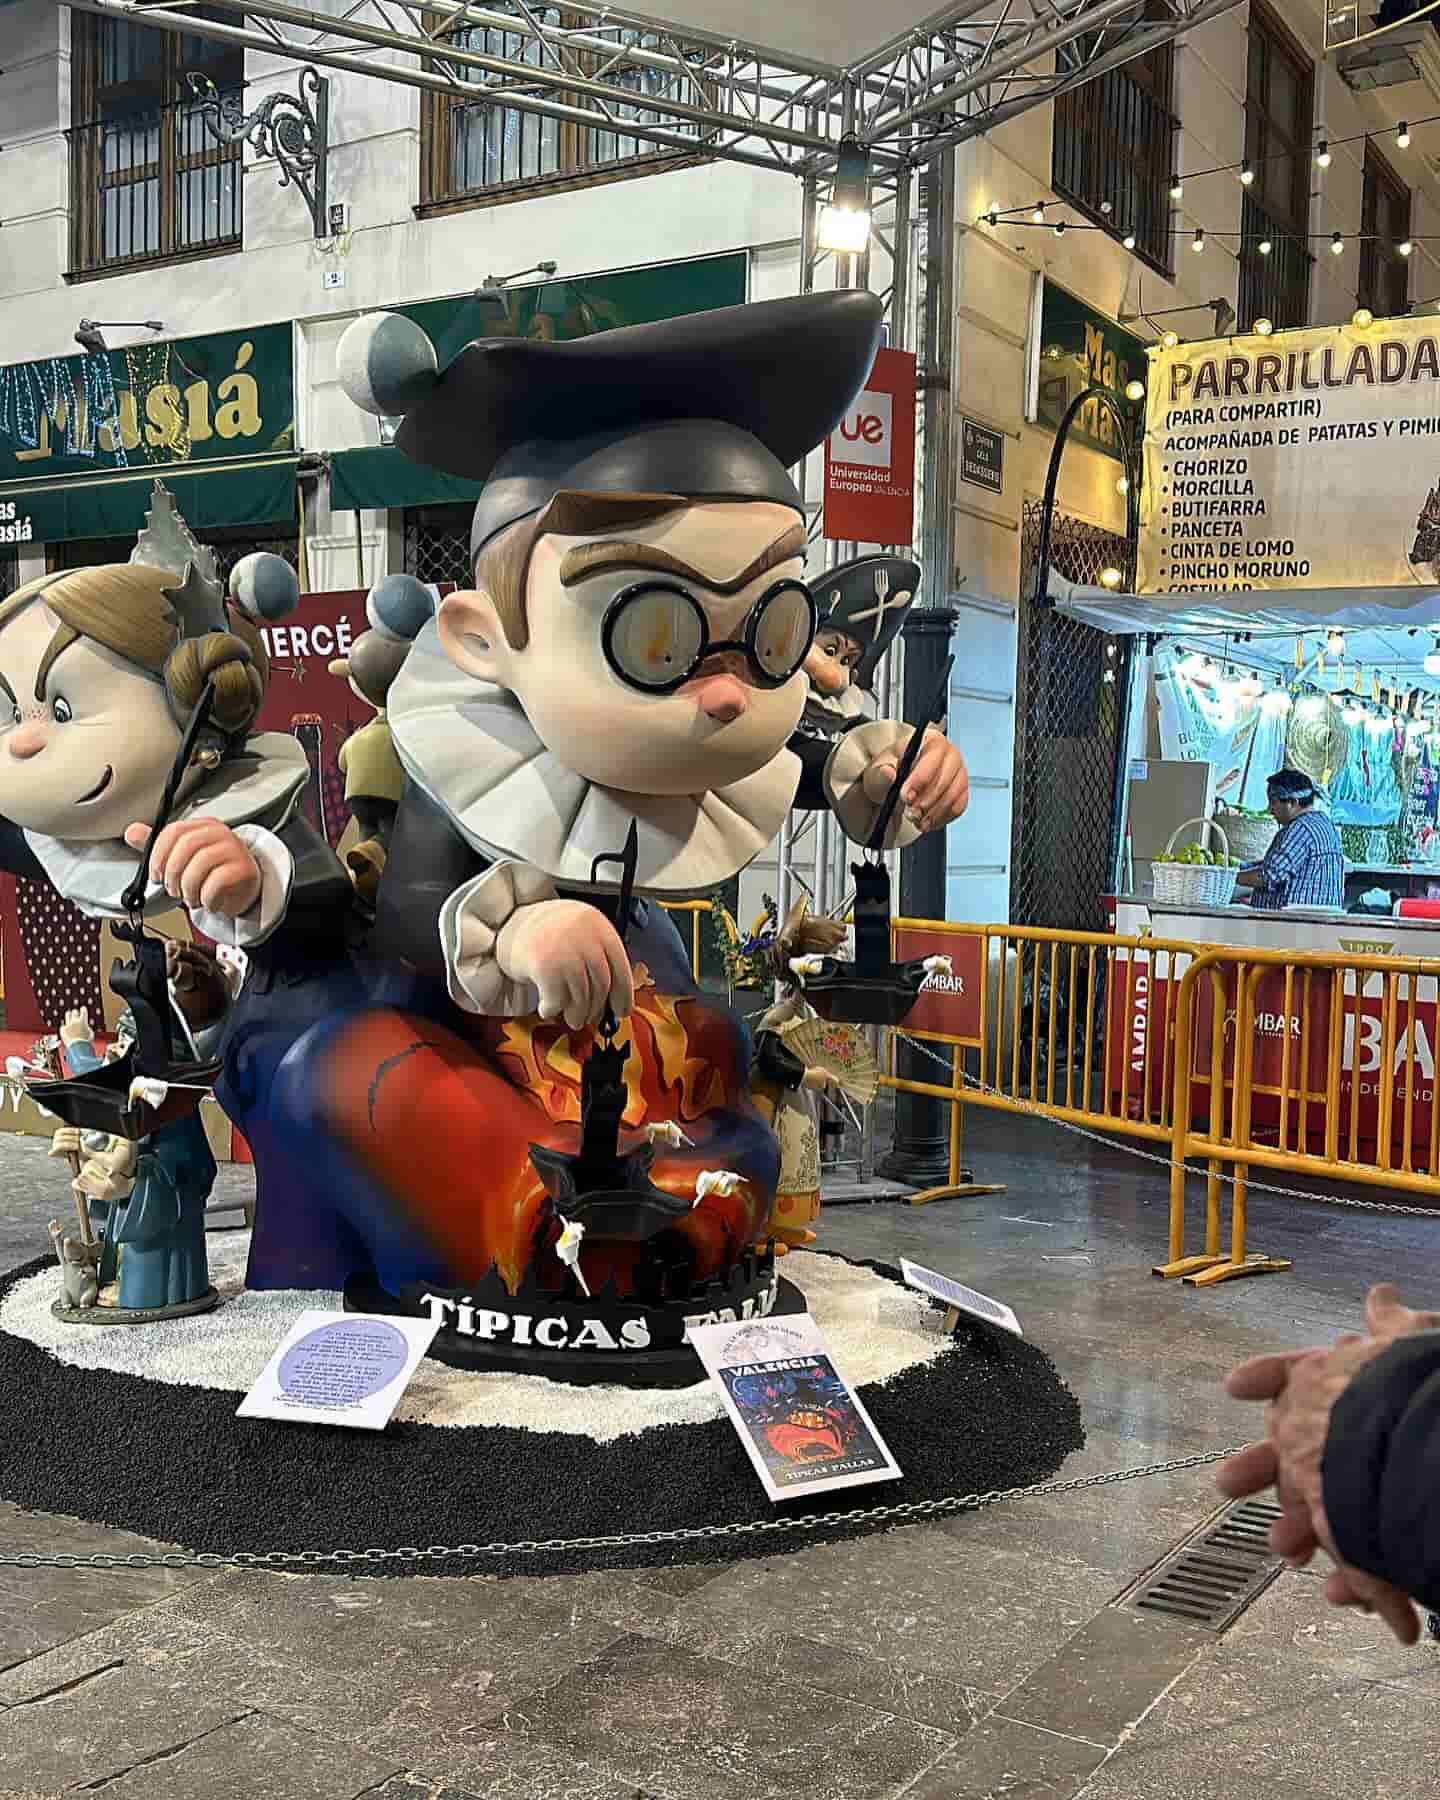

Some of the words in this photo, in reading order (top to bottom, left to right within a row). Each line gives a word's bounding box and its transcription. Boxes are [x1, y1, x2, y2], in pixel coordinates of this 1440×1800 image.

[1169, 337, 1440, 401] PARRILLADA
[1164, 406, 1215, 430] (PARA
[1219, 399, 1322, 422] COMPARTIR)
[1164, 430, 1274, 451] ACOMPAÑADA
[1278, 429, 1300, 445] DE
[1308, 422, 1377, 442] PATATAS
[1382, 421, 1395, 437] Y
[1399, 418, 1440, 436] PIMI
[830, 464, 890, 482] Universidad
[1174, 459, 1248, 476] CHORIZO
[830, 478, 872, 494] Europea
[1172, 479, 1254, 496] MORCILLA
[1172, 499, 1267, 517] BUTIFARRA
[1171, 521, 1243, 538] PANCETA
[1170, 542, 1214, 559] CINTA
[1219, 541, 1242, 558] DE
[1246, 540, 1294, 557] LOMO
[1170, 563, 1229, 580] PINCHO
[1233, 560, 1310, 578] MORUNO
[420, 1293, 652, 1349] TÍPICAS
[728, 1357, 819, 1377] VALENCIA
